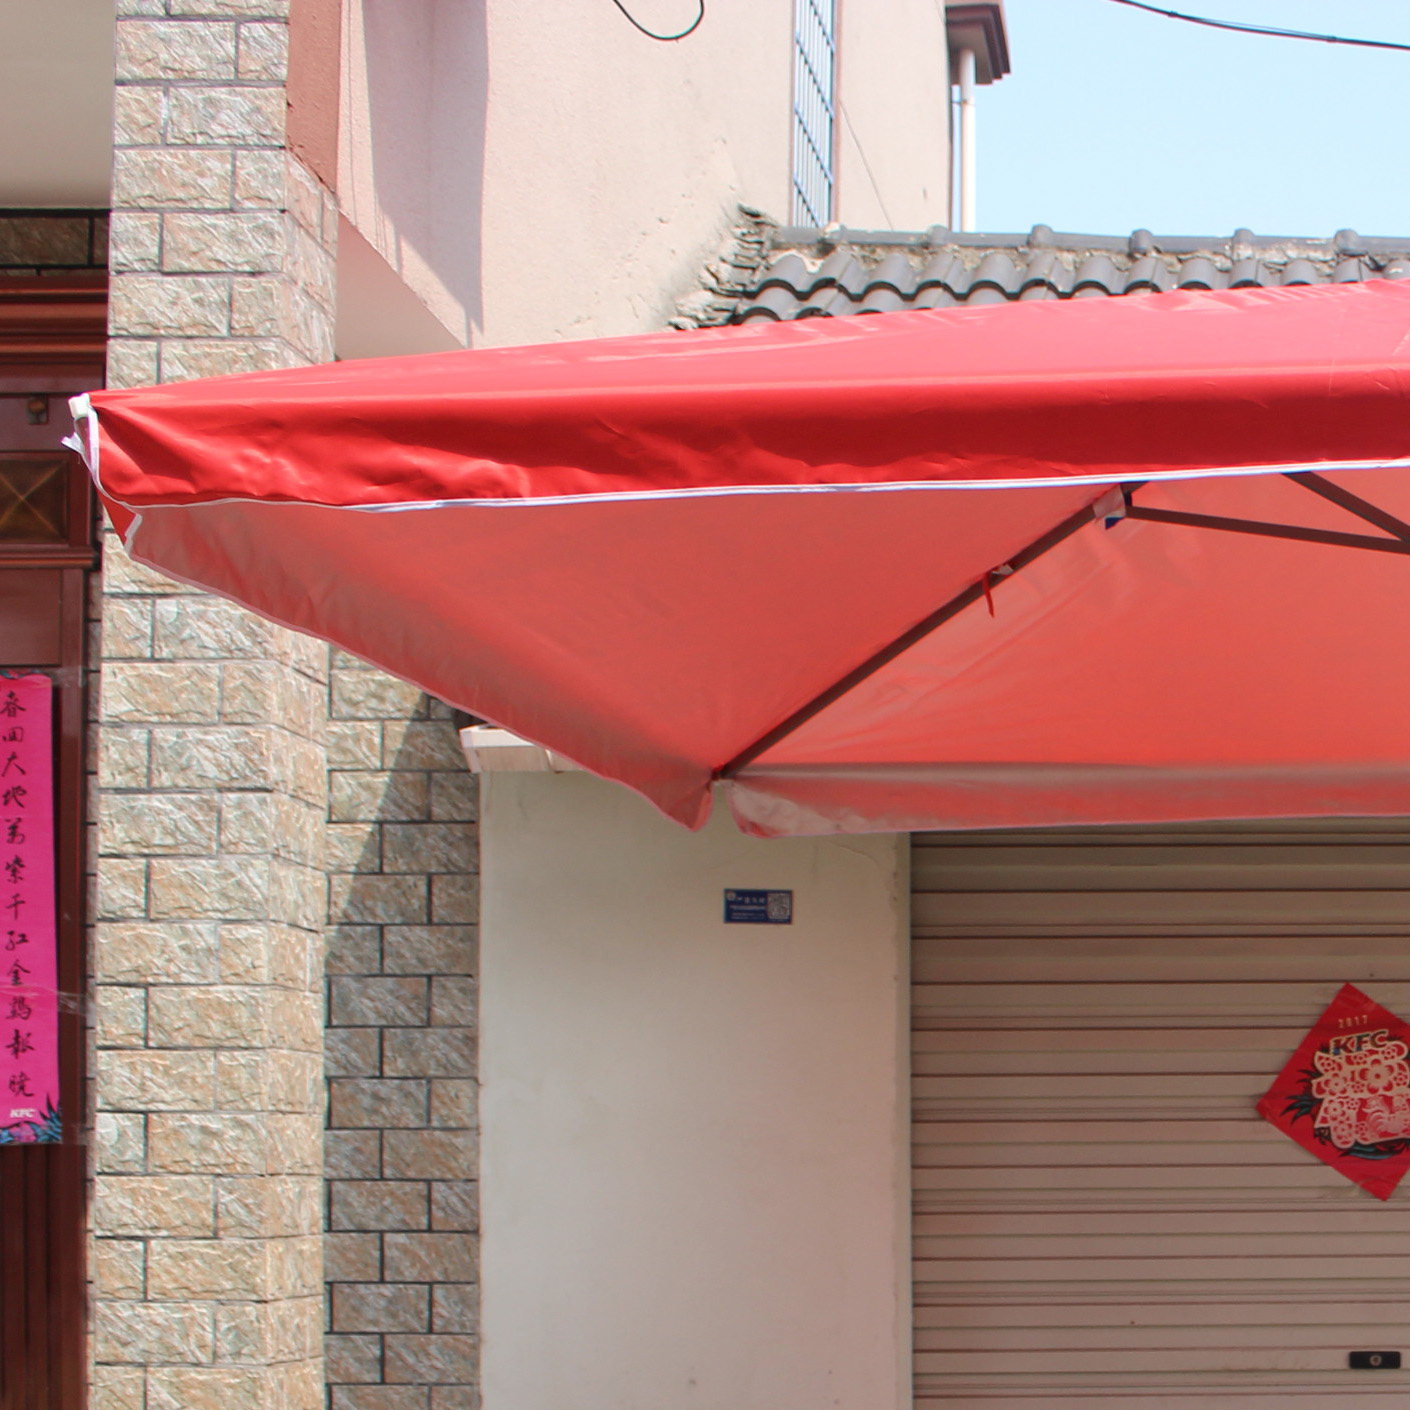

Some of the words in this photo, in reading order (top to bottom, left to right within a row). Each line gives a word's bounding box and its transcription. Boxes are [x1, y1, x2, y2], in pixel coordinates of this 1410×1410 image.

[1338, 1015, 1367, 1028] 2017
[1331, 1030, 1389, 1055] KFC
[10, 1108, 36, 1118] KFC
